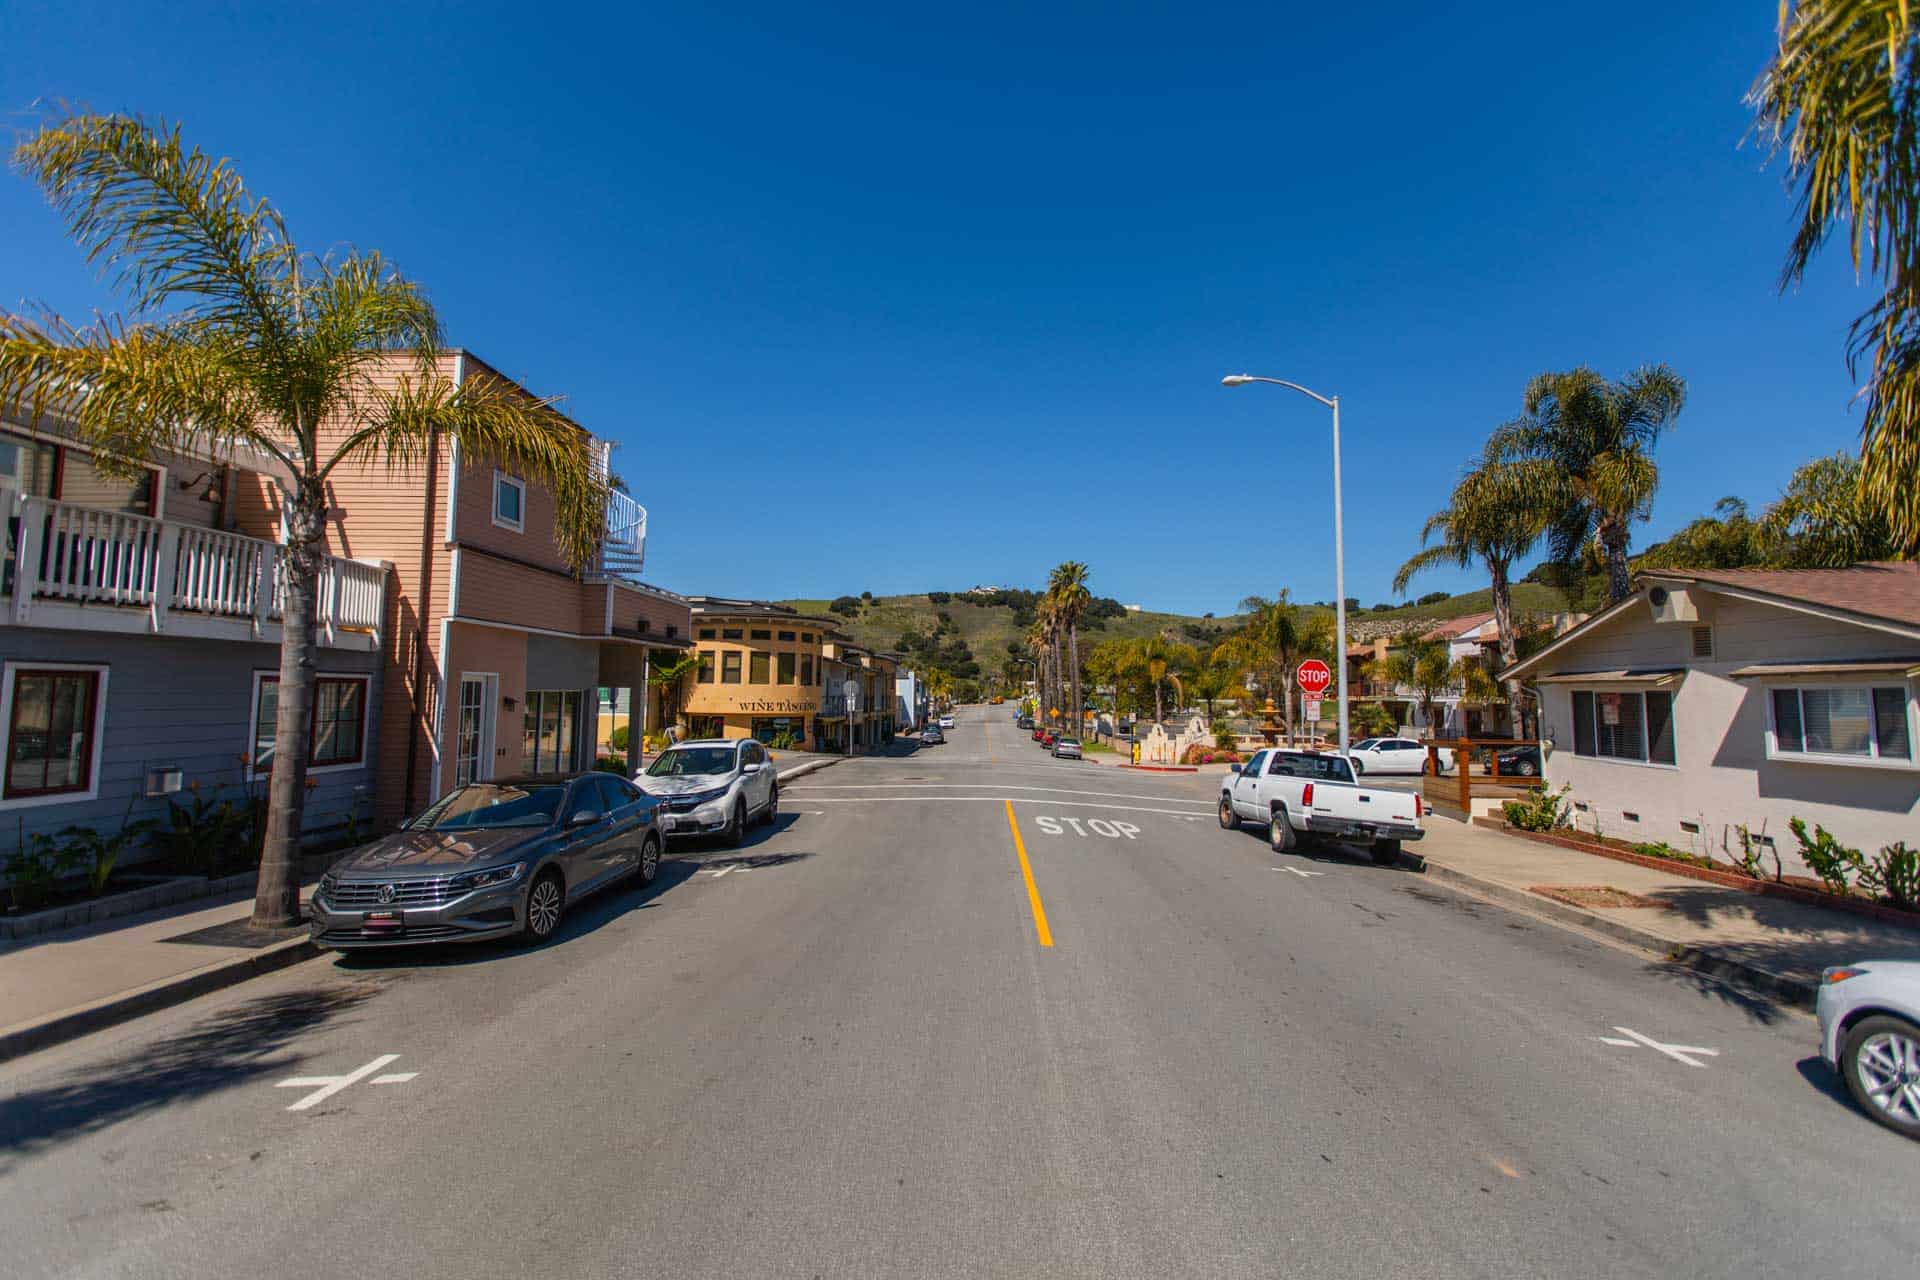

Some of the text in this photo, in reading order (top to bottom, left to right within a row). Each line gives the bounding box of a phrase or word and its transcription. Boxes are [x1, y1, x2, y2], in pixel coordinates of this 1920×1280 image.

[1300, 670, 1328, 683] STOP
[739, 702, 774, 712] WINE
[1035, 816, 1141, 839] STOP
